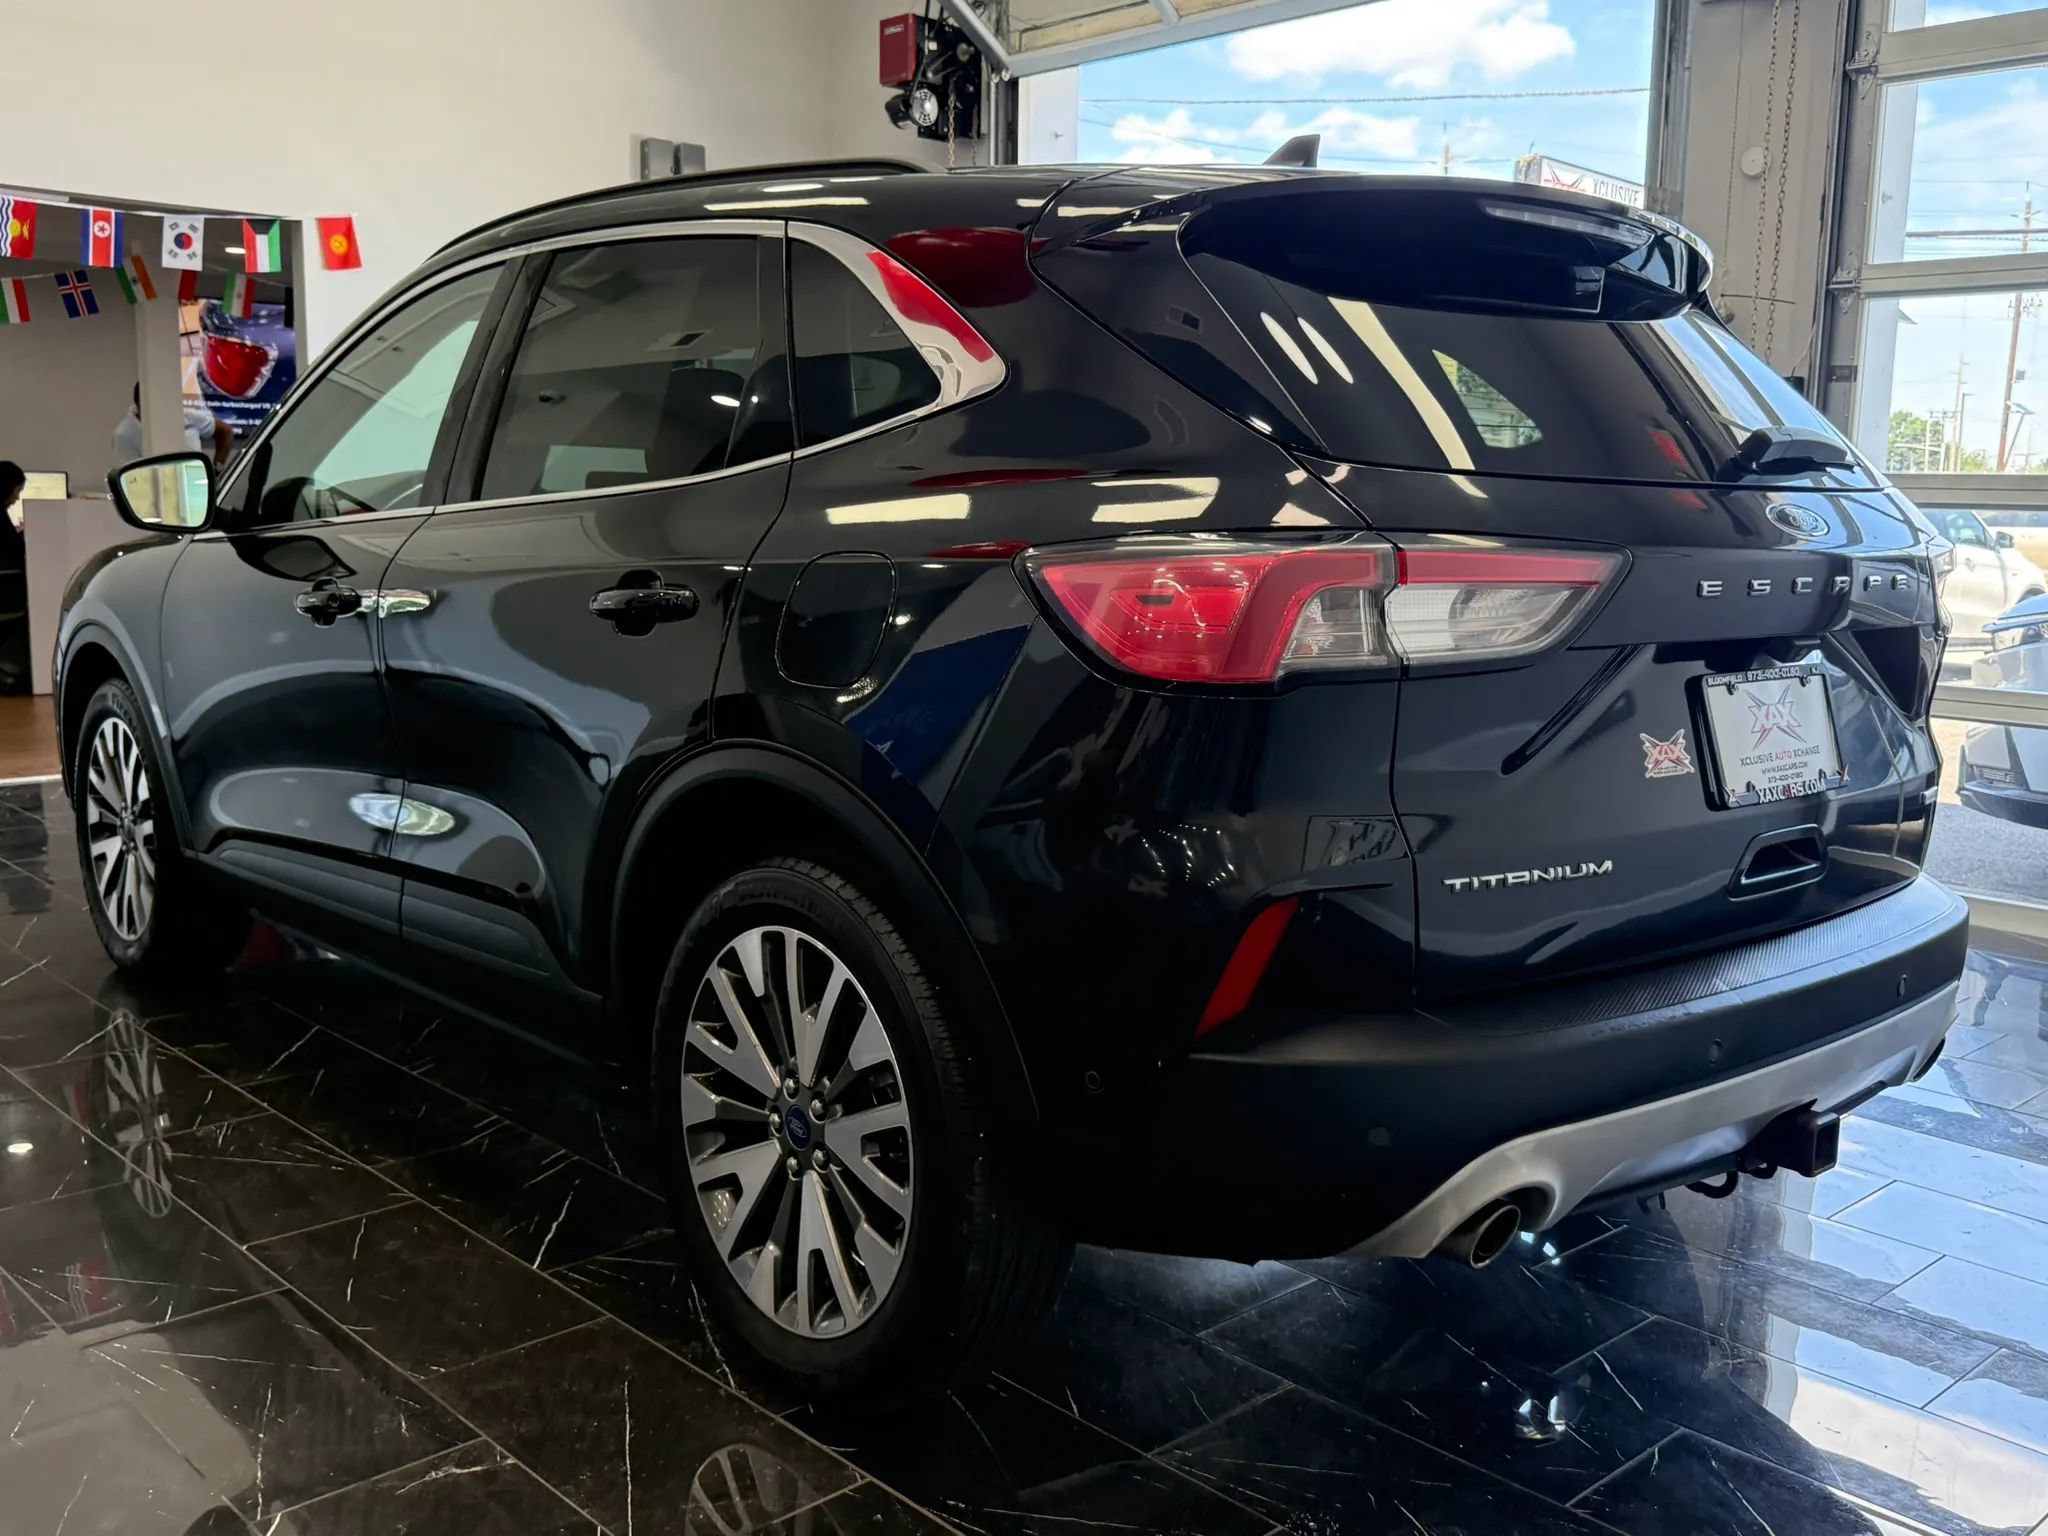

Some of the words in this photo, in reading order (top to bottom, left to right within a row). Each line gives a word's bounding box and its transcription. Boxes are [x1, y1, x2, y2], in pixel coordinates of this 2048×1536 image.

[1697, 573, 1909, 598] ESCAPE
[1740, 752, 1773, 767] XCLUSIVE
[1775, 749, 1793, 761] AUTO
[1793, 744, 1821, 758] XCHANGE
[1757, 777, 1827, 804] XAXCARS.COM
[1442, 859, 1613, 893] TITANIUM
